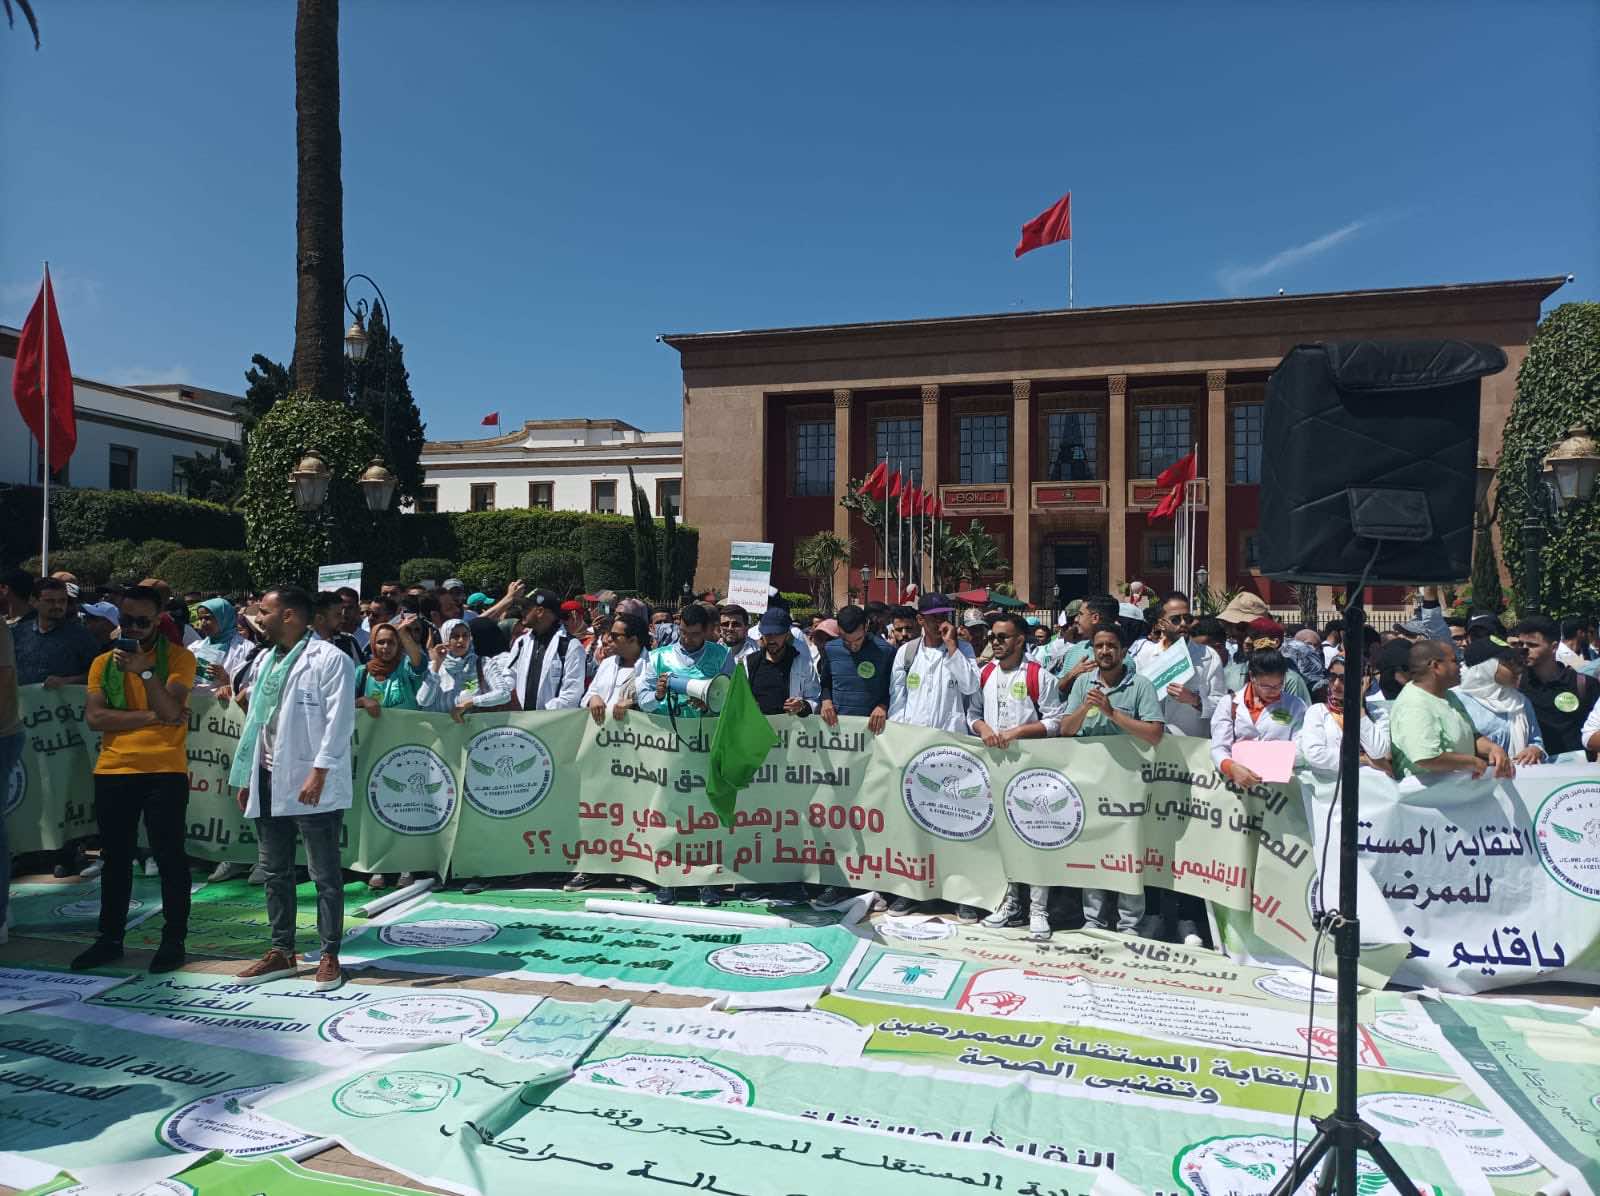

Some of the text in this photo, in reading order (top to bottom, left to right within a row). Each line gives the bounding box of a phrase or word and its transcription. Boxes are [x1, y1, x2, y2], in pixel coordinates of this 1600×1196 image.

[596, 728, 679, 752] للممرضين
[797, 729, 864, 752] النقابة
[675, 770, 705, 793] حق
[785, 767, 850, 786] العدالة
[579, 801, 884, 834] 8000 درهم هل هي وعد
[1098, 792, 1152, 817] الصحة
[562, 833, 653, 865] حكومي
[733, 833, 761, 872] أم
[772, 839, 835, 865] فقط
[1357, 821, 1533, 866] النقابة المست
[846, 848, 934, 888] إنتخابي
[878, 1017, 1330, 1093] النقابة المستقلة للممرضين
[959, 1047, 1074, 1077] الصحة
[123, 1061, 235, 1088] النقابة
[608, 1122, 812, 1154] للممرضين
[821, 1146, 1004, 1190] المستقلة
